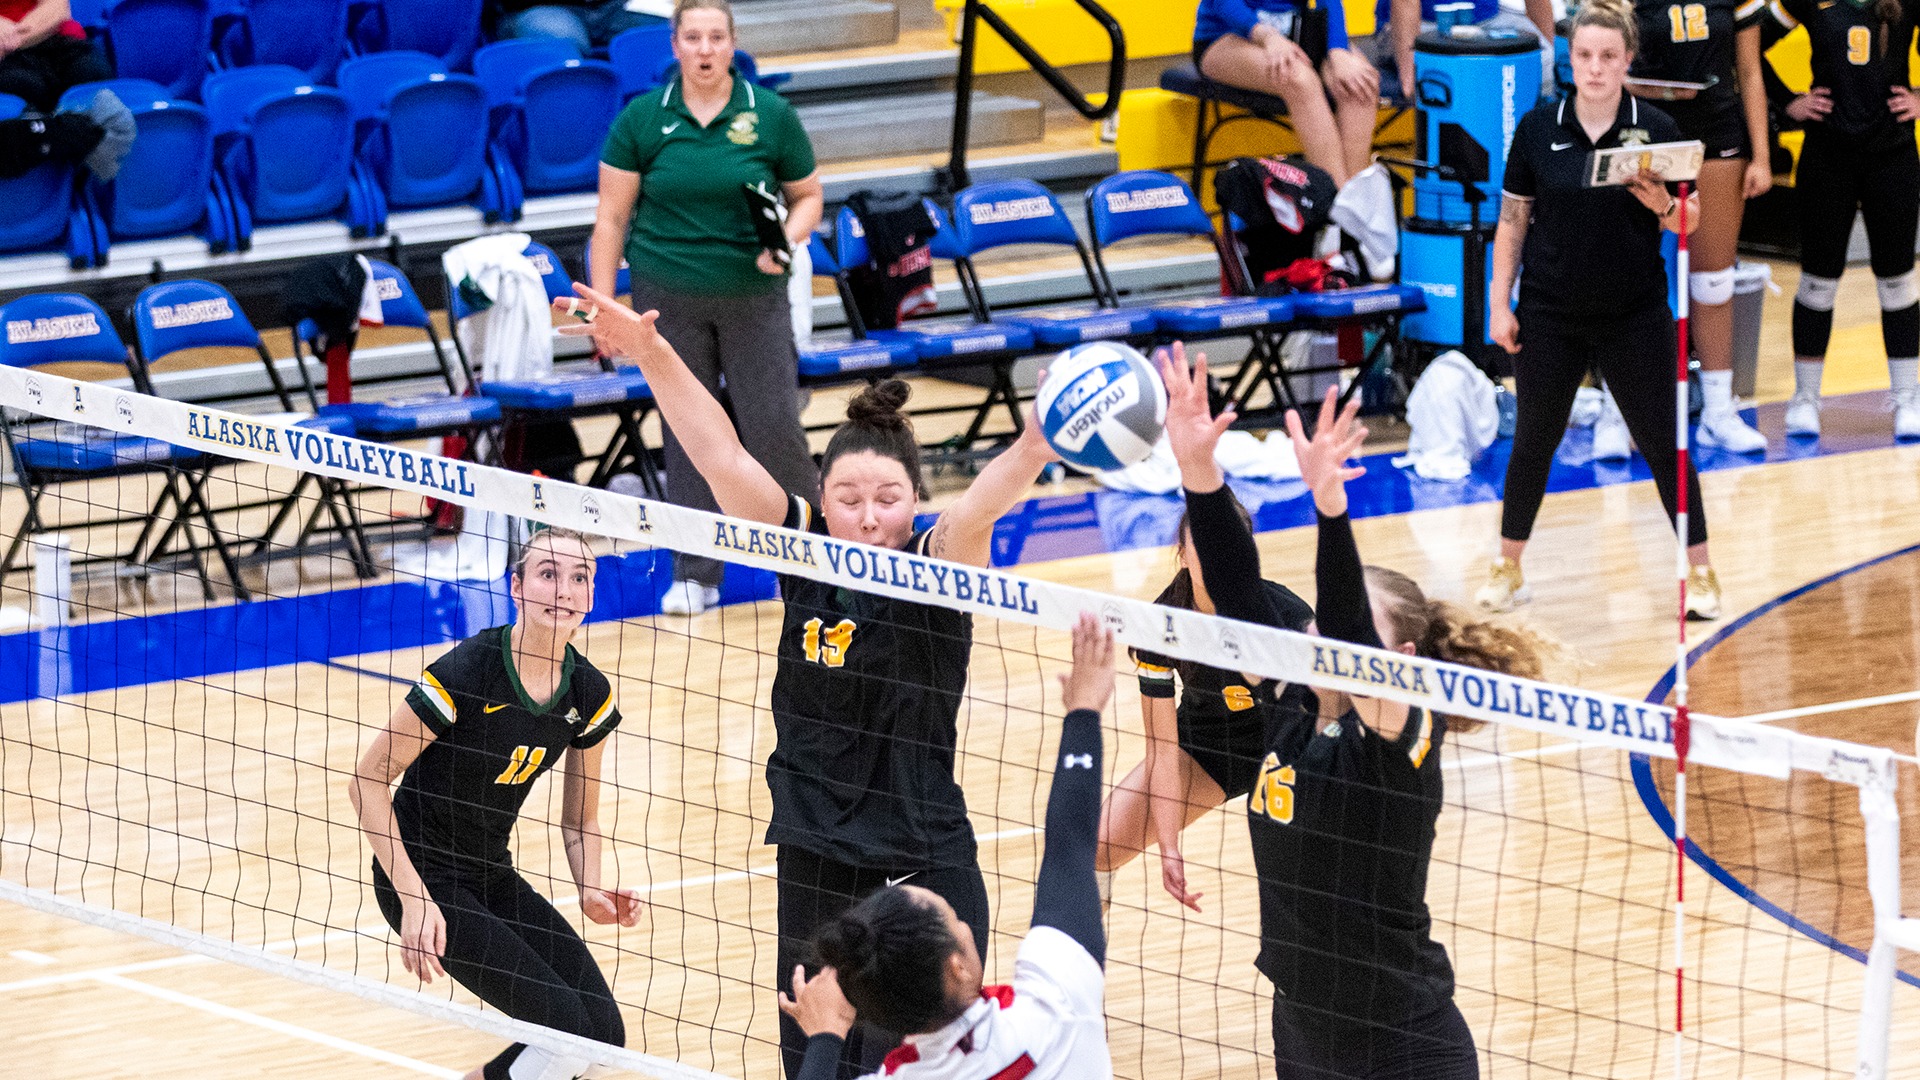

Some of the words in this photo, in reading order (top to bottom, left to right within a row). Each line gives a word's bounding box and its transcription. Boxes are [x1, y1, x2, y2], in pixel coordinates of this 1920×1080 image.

[1668, 3, 1709, 42] 12
[1847, 25, 1871, 65] 9
[7, 313, 101, 344] ALASKA
[152, 297, 234, 329] ALASKA
[1066, 386, 1126, 440] molten
[188, 411, 281, 454] ALASKA
[284, 429, 476, 498] VOLLEYBALL
[713, 520, 817, 566] ALASKA
[823, 541, 1039, 615] VOLLEYBALL
[1313, 645, 1431, 694] ALASKA
[494, 745, 547, 785] 11
[1250, 751, 1296, 824] 16
